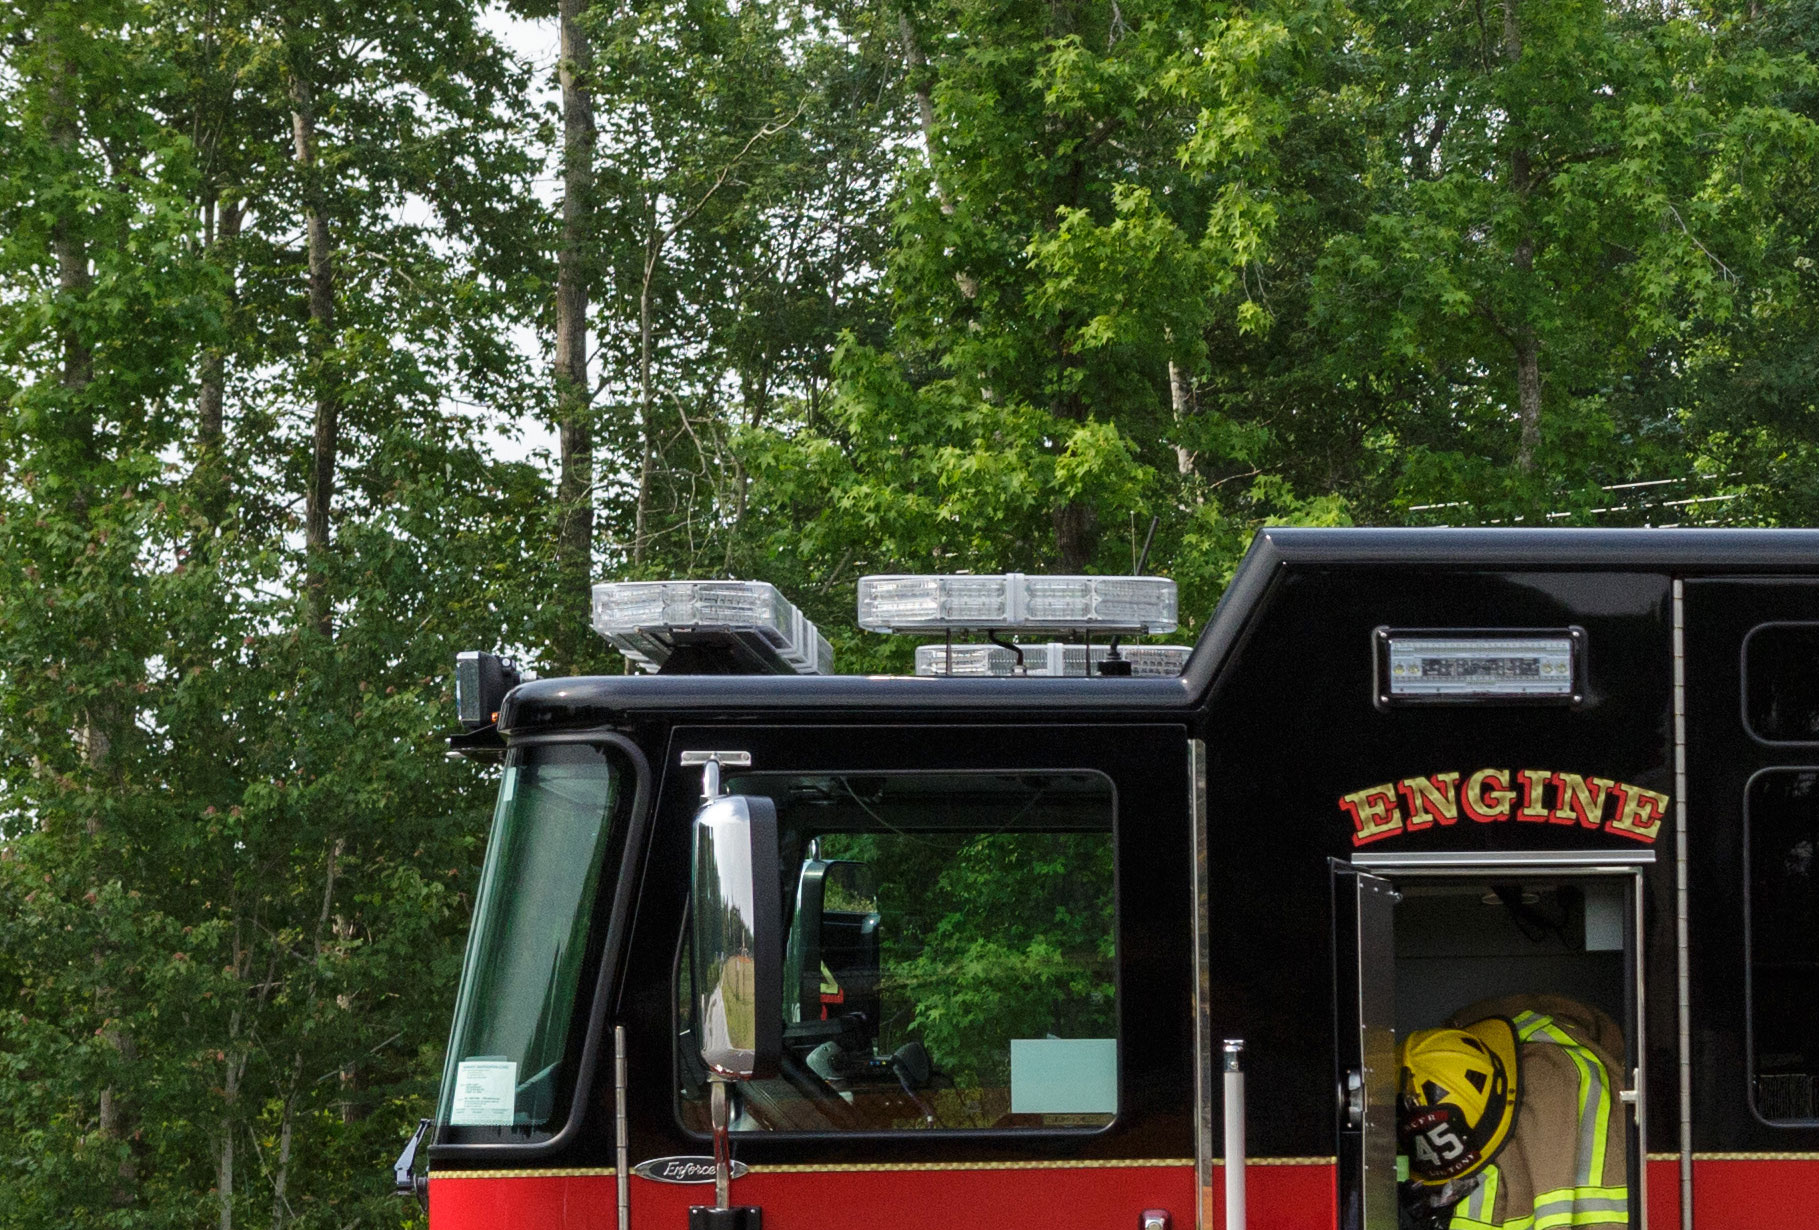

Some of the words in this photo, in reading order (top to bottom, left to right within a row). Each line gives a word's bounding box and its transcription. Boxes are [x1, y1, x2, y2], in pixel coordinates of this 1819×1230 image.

[1338, 768, 1669, 847] ENGINE
[1414, 1121, 1464, 1166] 45
[663, 1161, 724, 1180] Enforce
